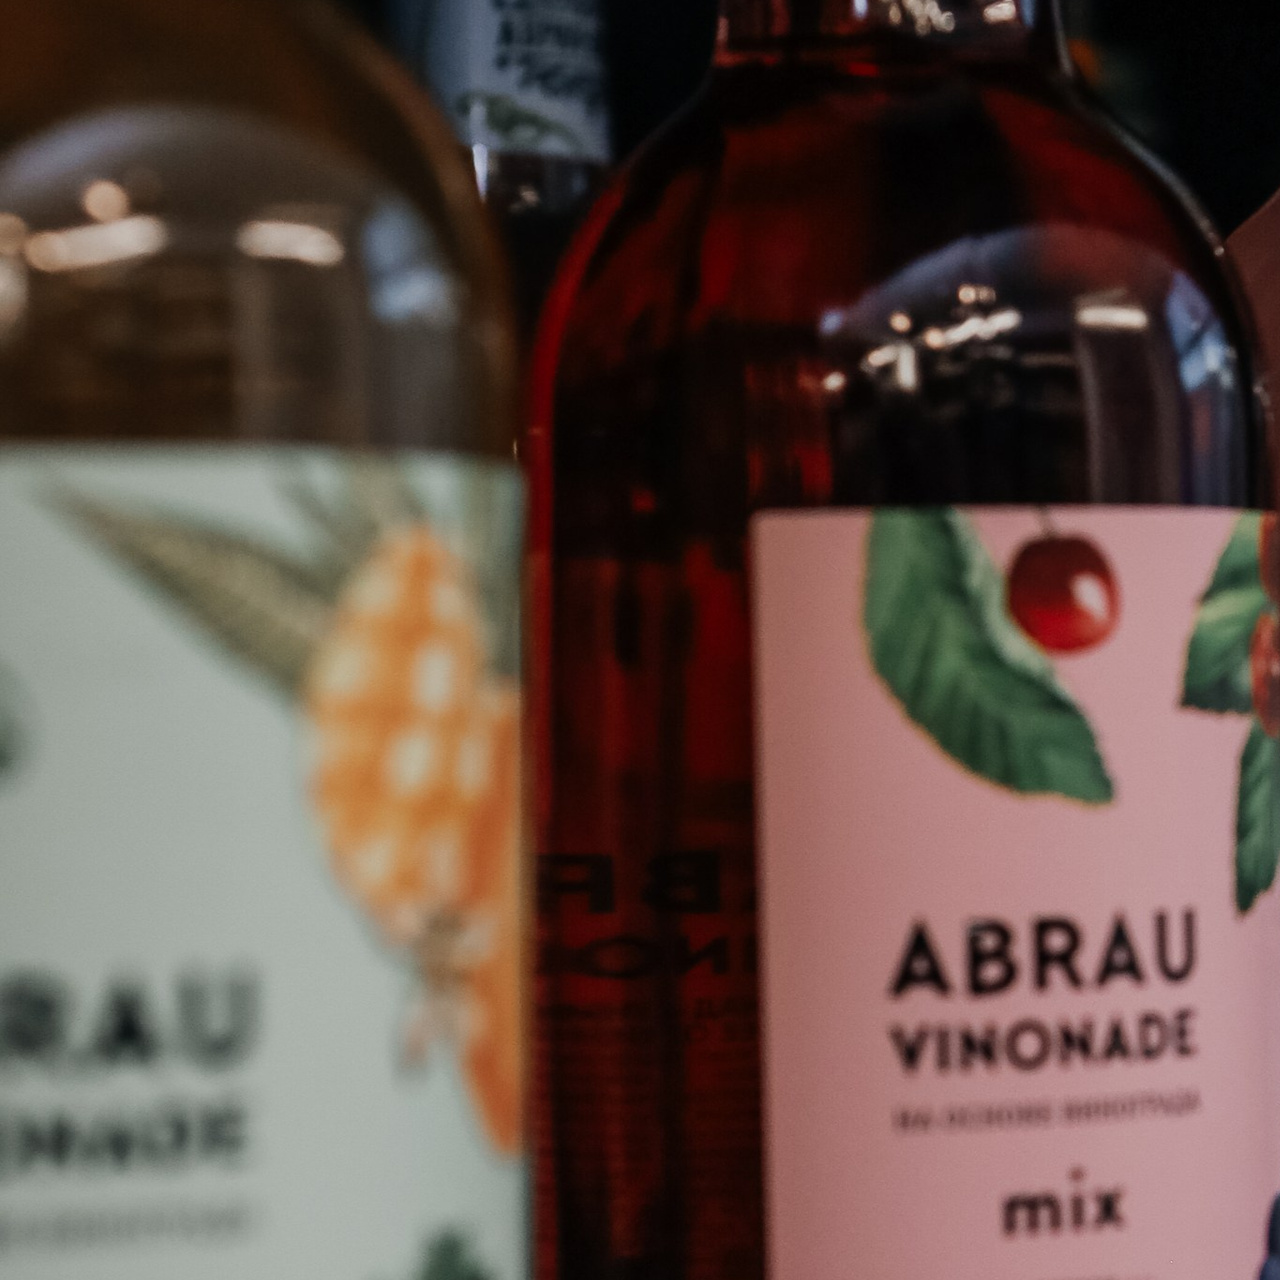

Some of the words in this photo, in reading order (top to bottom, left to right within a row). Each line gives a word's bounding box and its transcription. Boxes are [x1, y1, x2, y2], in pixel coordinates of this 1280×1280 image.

[889, 906, 1197, 998] ABRAU
[888, 1006, 1197, 1074] VINONADE
[1002, 1165, 1127, 1239] mix
